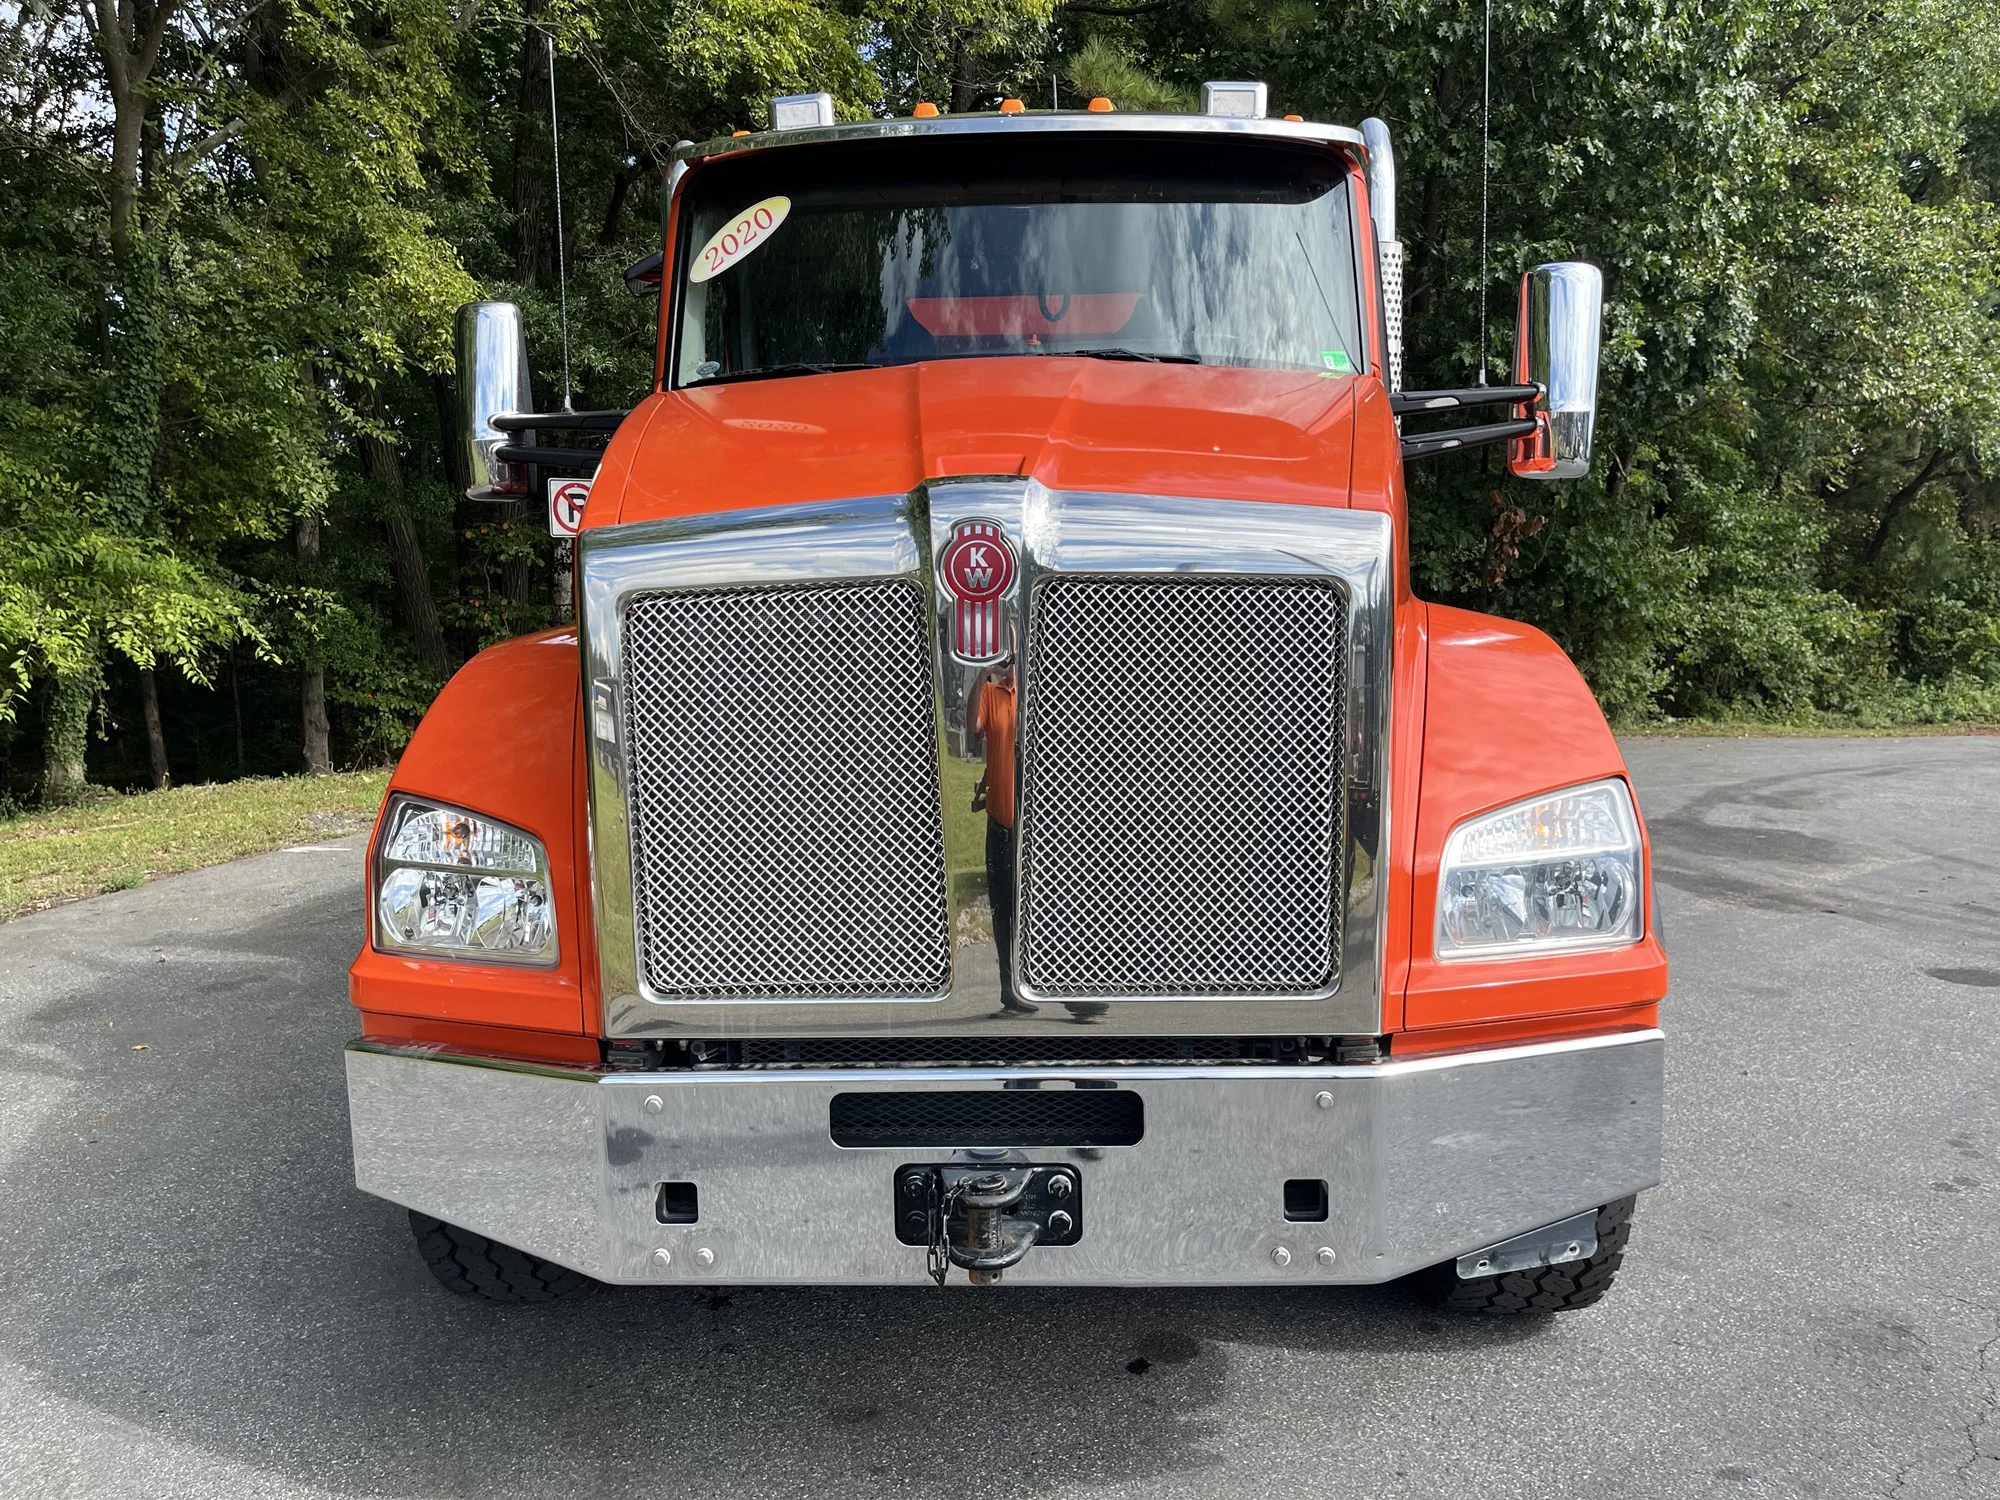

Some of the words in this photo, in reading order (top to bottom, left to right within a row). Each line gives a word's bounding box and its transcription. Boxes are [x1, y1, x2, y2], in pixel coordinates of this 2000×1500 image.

[705, 208, 773, 272] 2020
[970, 547, 989, 567] K
[964, 568, 993, 589] W
